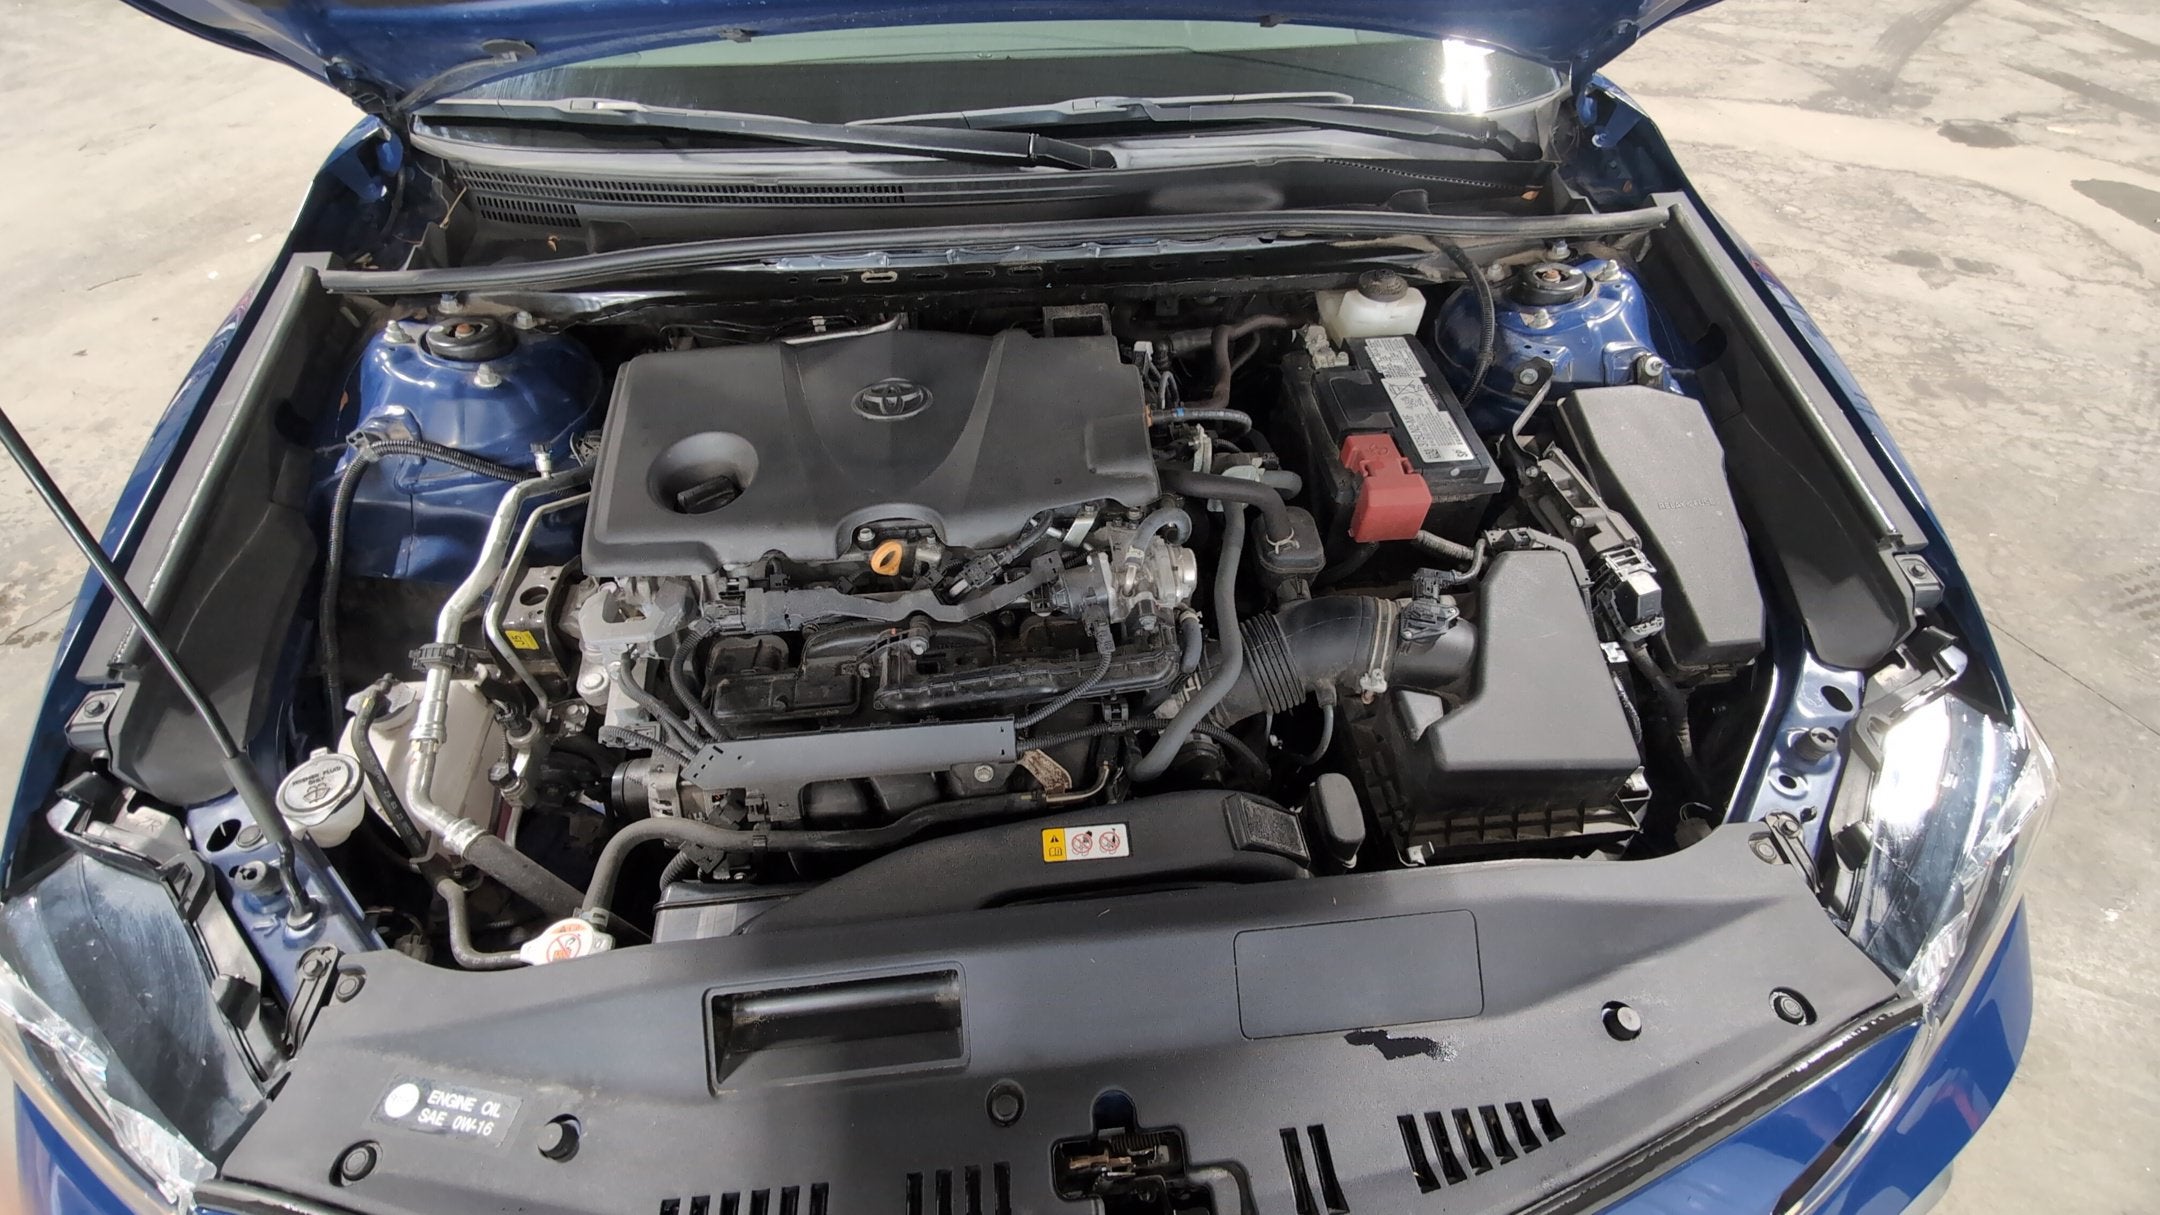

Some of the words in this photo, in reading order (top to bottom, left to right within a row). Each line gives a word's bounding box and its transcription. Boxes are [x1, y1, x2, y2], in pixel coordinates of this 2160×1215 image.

[427, 1090, 477, 1112] ENGINE
[481, 1101, 500, 1118] OIL
[418, 1108, 447, 1126] SAE
[452, 1115, 495, 1136] 0W-16
